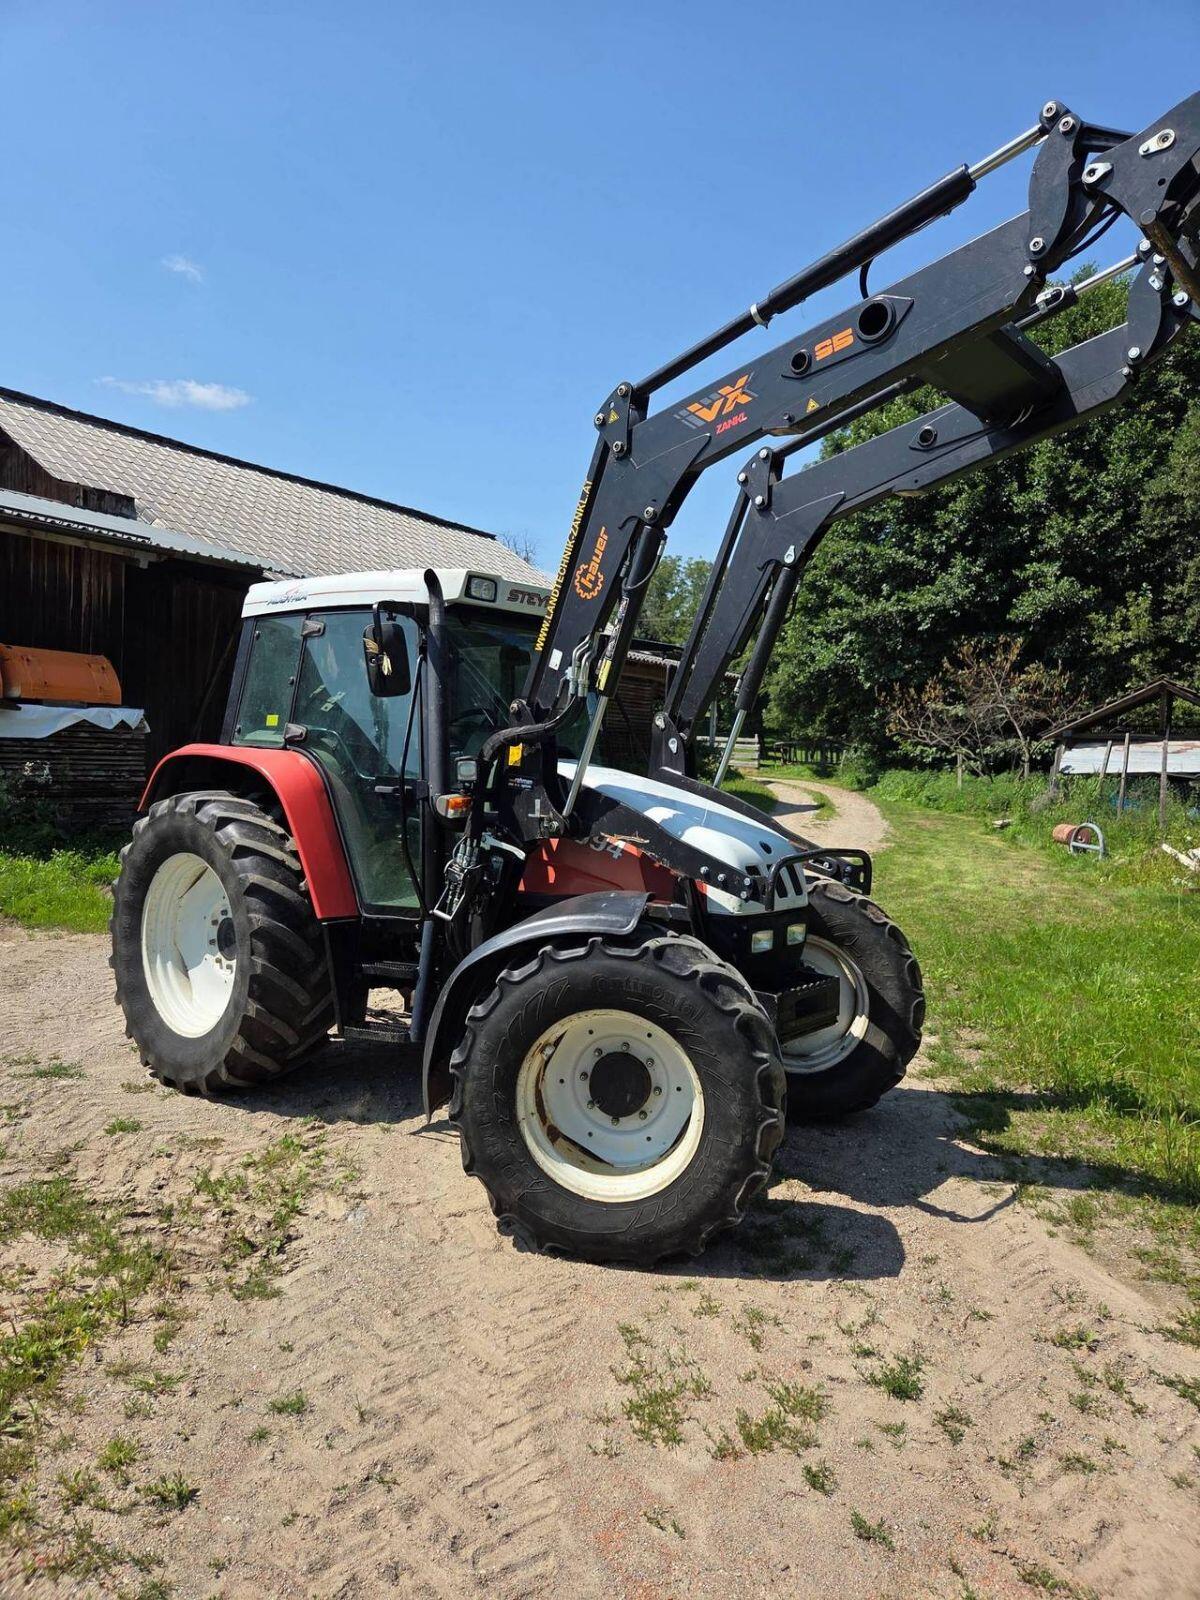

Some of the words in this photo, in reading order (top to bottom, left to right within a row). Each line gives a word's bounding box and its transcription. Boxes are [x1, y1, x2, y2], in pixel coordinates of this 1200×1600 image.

[686, 374, 753, 422] VX
[715, 411, 748, 435] ZANKL
[534, 480, 593, 652] WWW.LANDTECHNIK-ZANKL.AT
[580, 526, 609, 590] hauer
[507, 588, 551, 609] STEY
